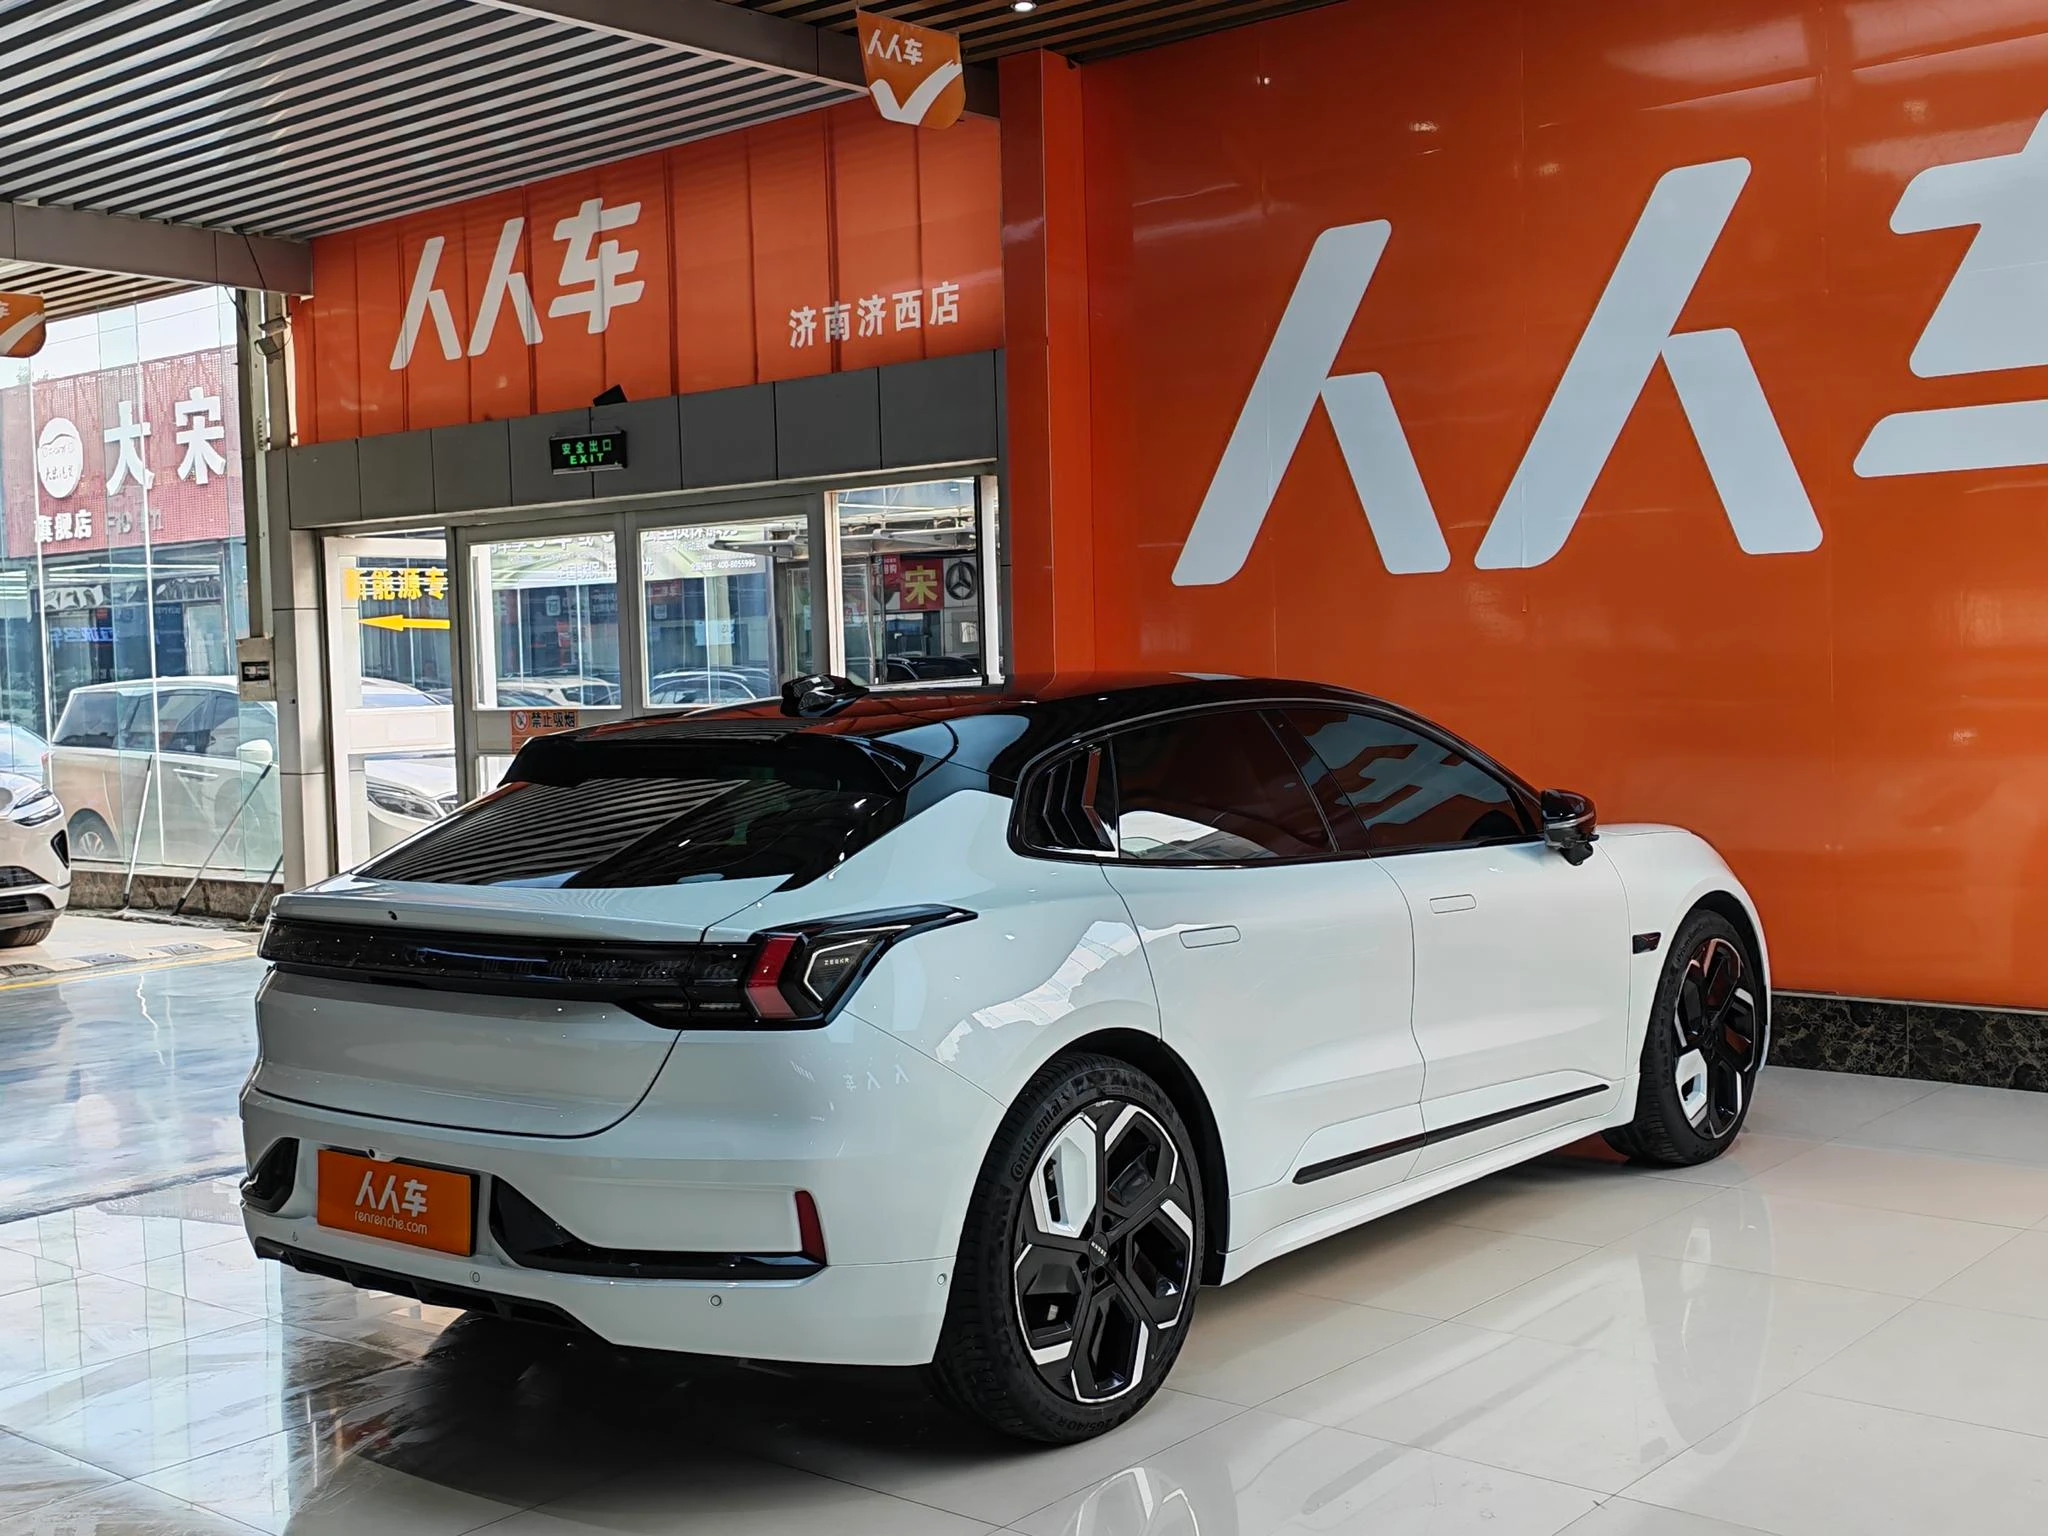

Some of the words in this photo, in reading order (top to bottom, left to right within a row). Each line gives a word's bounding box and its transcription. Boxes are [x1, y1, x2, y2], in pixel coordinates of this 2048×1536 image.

[867, 28, 923, 66] 人人车
[389, 197, 645, 371] 人人车
[788, 281, 961, 349] 济南济西店
[103, 387, 226, 497] 大宋
[561, 438, 612, 456] 安全出口
[569, 452, 604, 465] EXIT
[904, 565, 938, 605] 宋
[531, 711, 575, 728] 禁止吸烟
[355, 1171, 428, 1217] 人人车
[354, 1210, 428, 1235] renrenche.com
